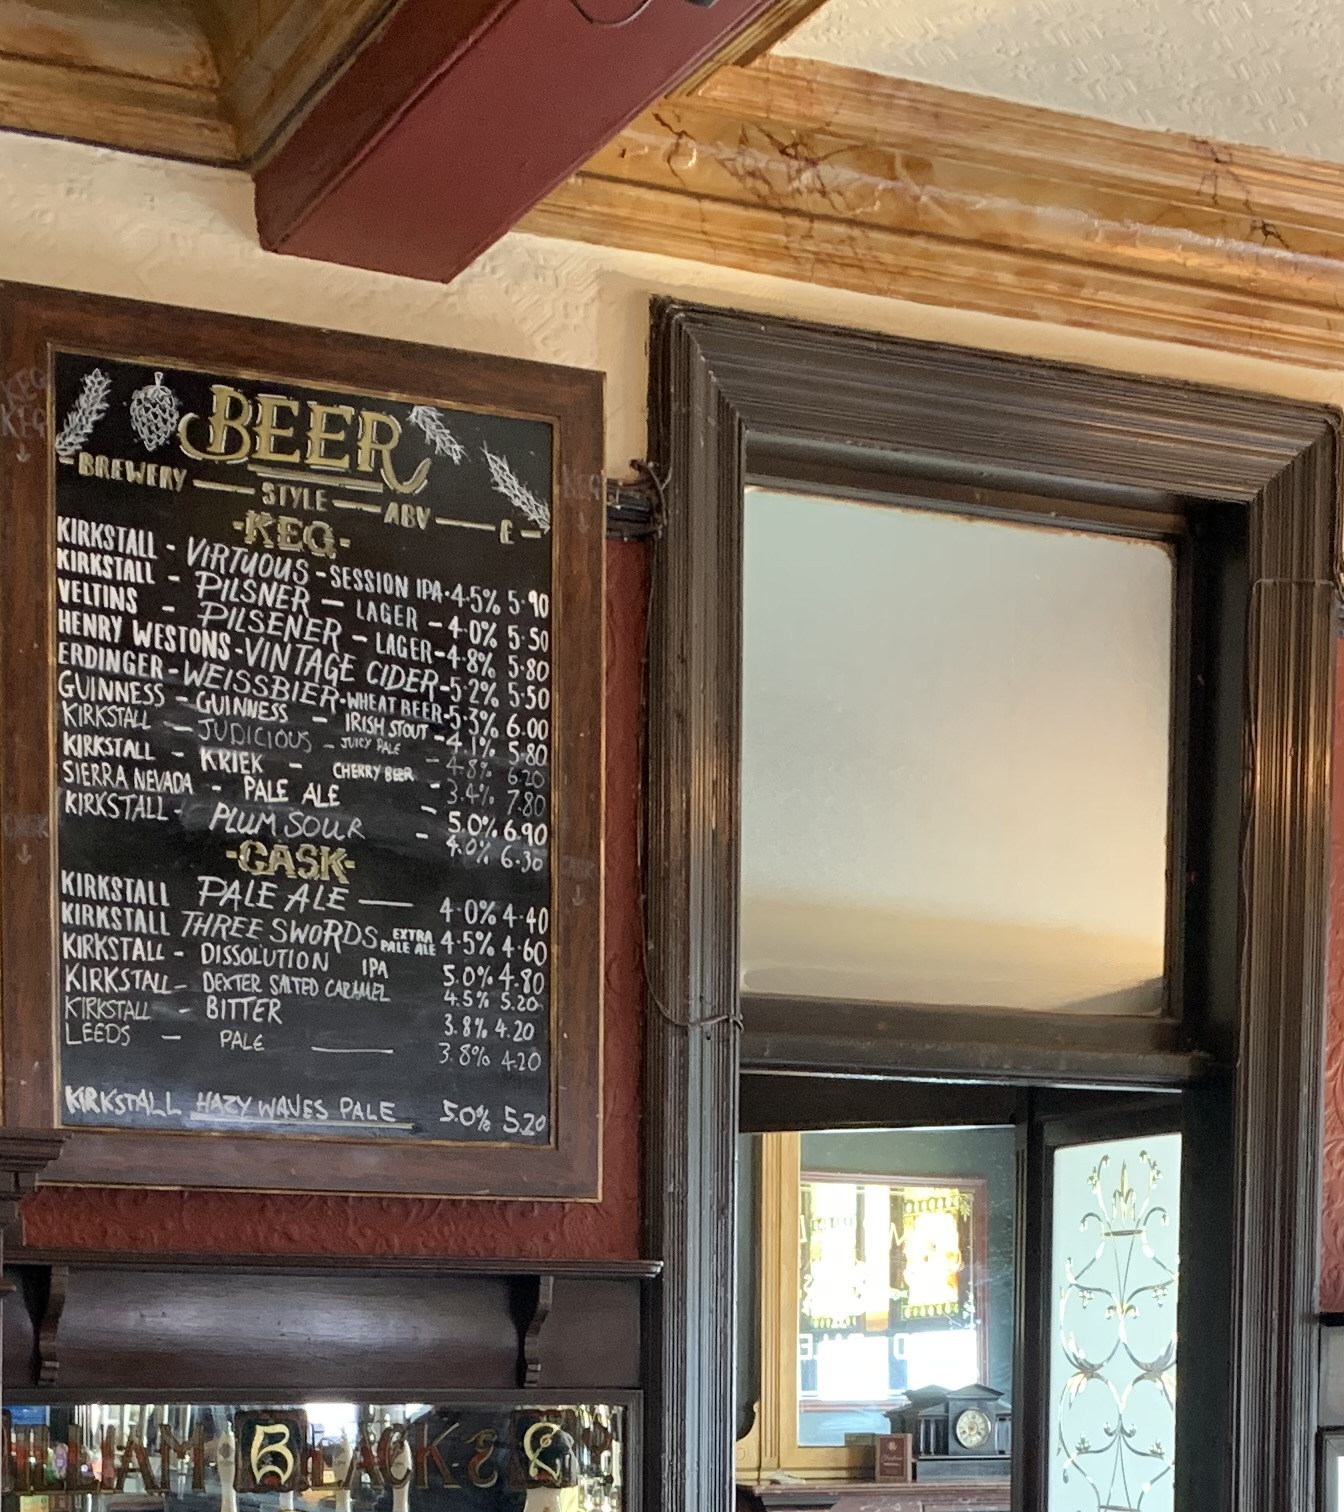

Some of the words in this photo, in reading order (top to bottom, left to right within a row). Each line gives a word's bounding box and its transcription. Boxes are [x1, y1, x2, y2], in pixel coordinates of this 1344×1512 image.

[177, 384, 432, 494] BEER
[78, 452, 187, 492] BREWERY
[261, 482, 328, 512] STYLE
[385, 502, 430, 530] ABV
[57, 516, 157, 559] KIRKSTALL
[187, 536, 309, 585] VIRTUOUS
[330, 565, 408, 598] SESSION
[417, 579, 442, 603] IPA
[57, 548, 155, 584] KIRKSTALL
[195, 571, 310, 618] PILSNER
[357, 600, 418, 631] LAGER
[58, 578, 138, 614] VELTINS
[197, 601, 342, 653] PILSENER
[376, 632, 432, 664] LAGER
[58, 608, 122, 643] HENRY
[133, 620, 231, 661] WESTONS
[245, 637, 356, 687] VINTAGE
[367, 661, 439, 702] CIDER
[58, 641, 163, 680] ERDINGER
[184, 659, 340, 714] WEISSBIER
[347, 692, 400, 713] WHEAT
[401, 699, 443, 724] BEER
[506, 714, 549, 740] 6.00
[58, 670, 165, 707] GUINNESS
[196, 691, 288, 723] GUINNESS
[346, 712, 384, 737] IRISH
[388, 719, 429, 740] STOUT
[62, 700, 151, 730] KIRKSTALL
[198, 718, 312, 752] JUDICIOUS
[340, 736, 372, 750] JUICY
[376, 738, 401, 755] PALE
[507, 768, 545, 789] 6.20
[62, 731, 156, 760] KIRKSTALL
[200, 746, 264, 774] KRIEK
[333, 762, 381, 781] CHERRY
[385, 766, 415, 782] BEER
[506, 789, 546, 817] 7.80
[62, 760, 129, 790] SIERRA
[133, 767, 194, 795] NEVADA
[244, 776, 289, 803] PALE
[301, 782, 340, 808] ALE
[448, 811, 497, 838] 5.0%
[504, 819, 548, 846] 6.90
[64, 790, 169, 822] KIRKSTALL
[209, 801, 276, 837] PLUM
[285, 811, 365, 840] SOUR
[446, 835, 490, 864] 4.0%
[501, 846, 543, 873] 6.30
[62, 870, 170, 907] KIRKSTALL
[198, 876, 278, 911] PALE
[284, 880, 349, 912] ALE
[62, 902, 170, 936] KIRKSTALL
[181, 911, 264, 941] THREE
[270, 918, 378, 953] SWORDS
[63, 932, 165, 961] KIRKSTALL
[201, 942, 329, 971] DISSOLUTION
[362, 958, 388, 979] IPA
[443, 965, 493, 987] 5.0%
[498, 962, 544, 994] 4.80
[381, 941, 410, 954] PALE
[414, 943, 436, 956] ALE
[393, 928, 433, 943] EXTRA
[65, 962, 172, 994] KIRKSTALL
[203, 971, 262, 993] DEXTER
[270, 974, 318, 996] SALTED
[325, 979, 391, 1002] CARAMEL
[444, 989, 489, 1009] 4.5%
[501, 992, 539, 1012] 5.20
[65, 995, 151, 1020] KIRKSTALL
[206, 995, 283, 1024] BITTER
[445, 1014, 487, 1038] 3.8%
[495, 1019, 534, 1042] 4.20
[65, 1022, 130, 1046] LEEDS
[220, 1030, 264, 1050] PALE
[439, 1042, 490, 1066] 3.8%
[502, 1051, 541, 1071] 4.20
[65, 1085, 181, 1116] KIRKSTALL
[196, 1091, 252, 1116] HAZY
[259, 1094, 328, 1119] WAVES
[340, 1097, 396, 1121] PALE
[503, 1106, 546, 1136] 5.20
